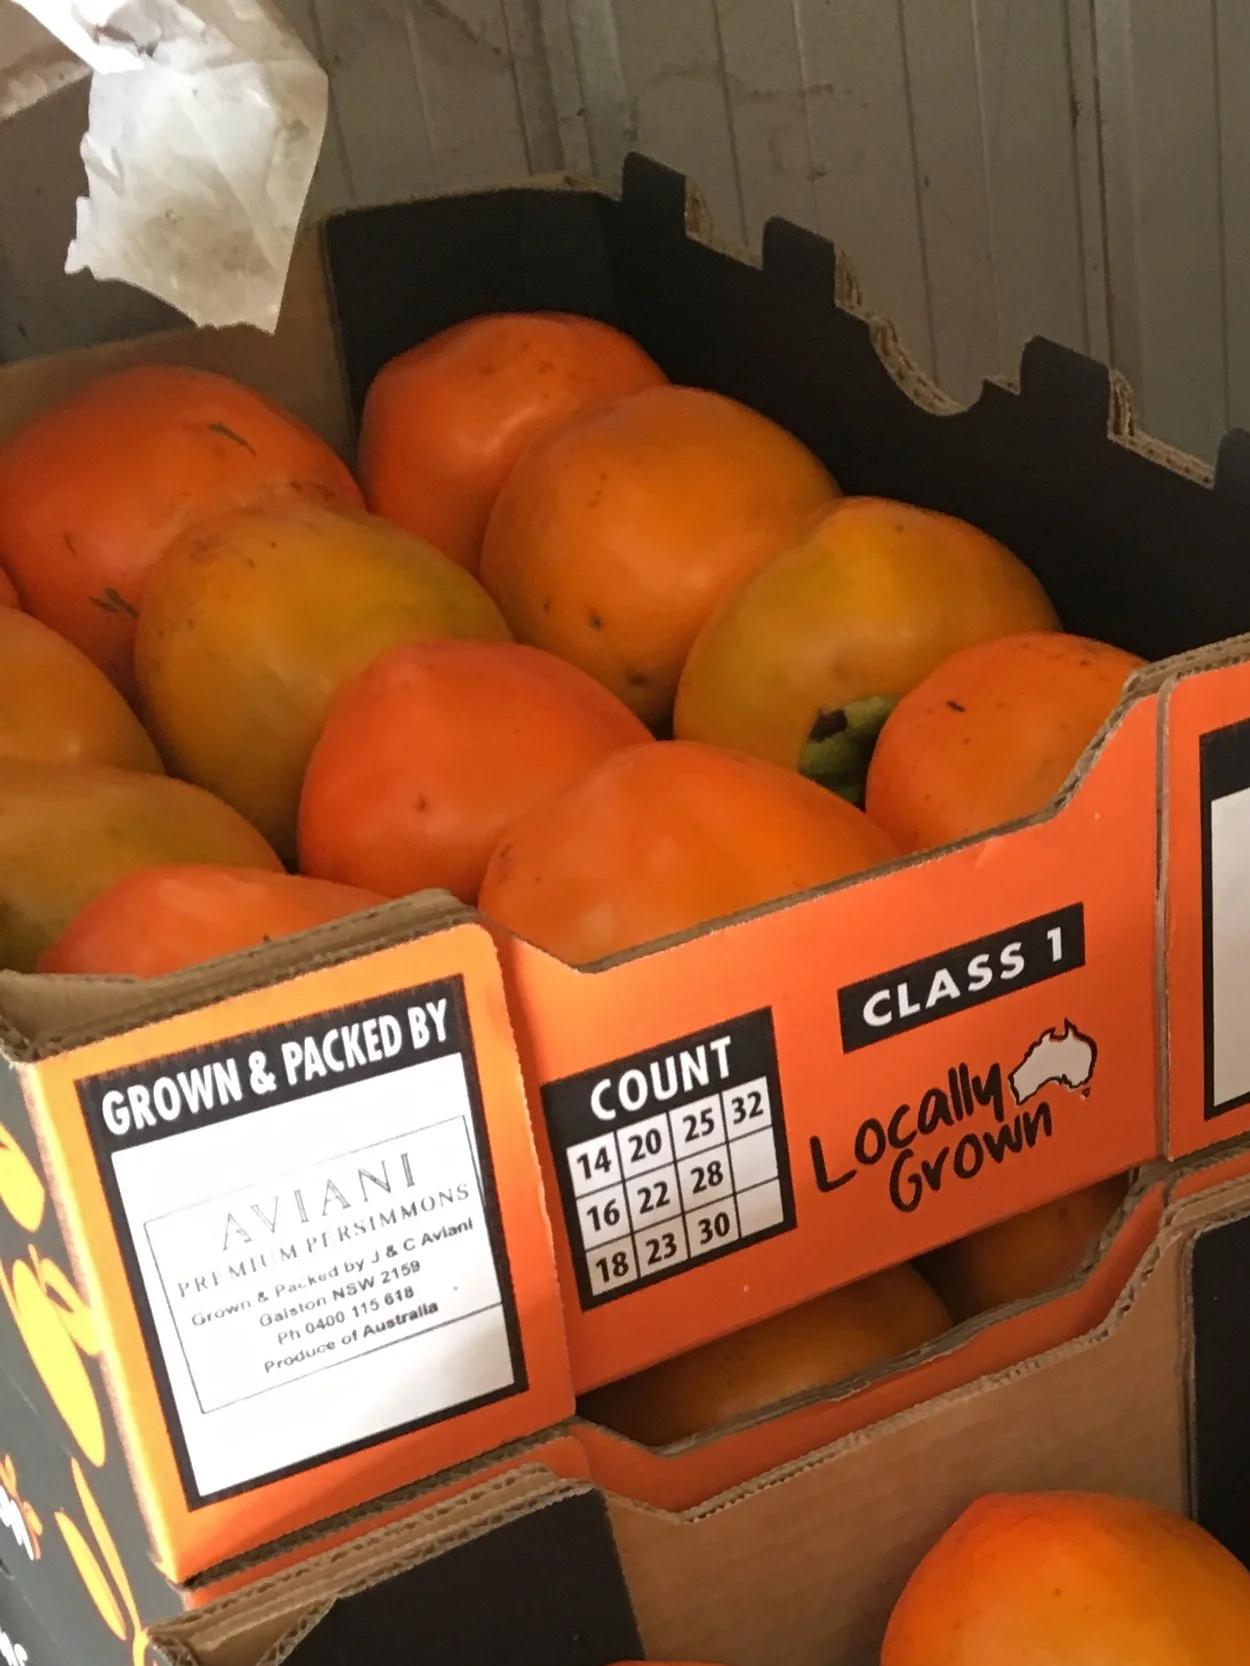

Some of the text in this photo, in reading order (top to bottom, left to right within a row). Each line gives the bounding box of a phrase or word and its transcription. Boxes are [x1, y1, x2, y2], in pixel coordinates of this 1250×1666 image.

[862, 925, 1063, 1028] CLASS 1
[102, 997, 448, 1137] GROWN & PACKED BY
[590, 1035, 732, 1121] COUNT
[576, 1090, 764, 1181] 14 20 25 32
[809, 1061, 1005, 1194] Locally
[889, 1101, 1054, 1213] Grown
[176, 1182, 471, 1298] PREMIUM PERSIMMONS
[222, 1152, 416, 1251] AVIANI
[585, 1159, 725, 1233] 16 22 28
[191, 1216, 475, 1327] Grown & Packed by J & C Aviani
[259, 1259, 422, 1328] Galston NSW 2159
[595, 1211, 731, 1284] 18 23 30
[263, 1301, 440, 1374] Produce of Australia
[277, 1328, 301, 1346] Ph
[305, 1310, 346, 1335] 0400
[351, 1299, 380, 1319] 115
